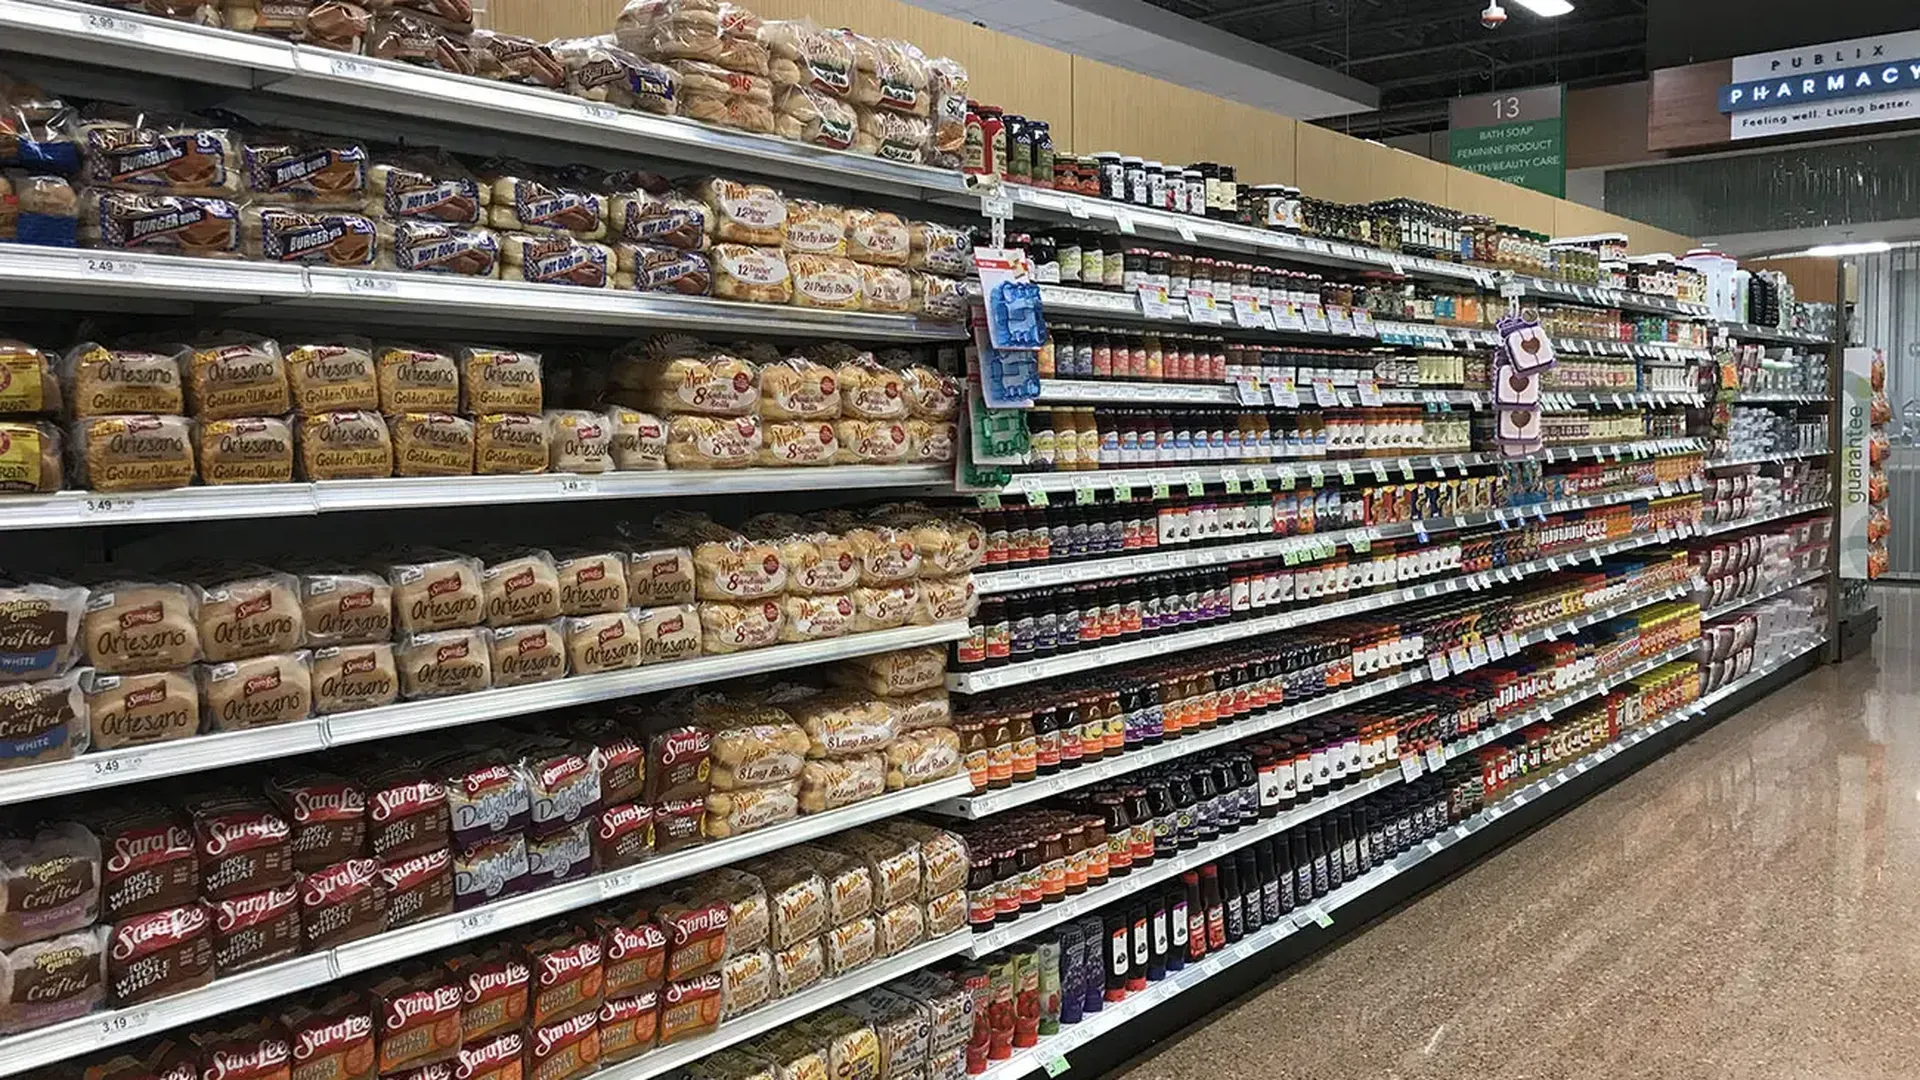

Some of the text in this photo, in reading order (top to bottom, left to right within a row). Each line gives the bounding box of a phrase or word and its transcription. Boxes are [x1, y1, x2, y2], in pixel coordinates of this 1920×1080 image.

[89, 15, 114, 29] 2.99
[1771, 45, 1883, 71] PUBLIX
[1731, 65, 1920, 104] PHARMACY
[1493, 97, 1520, 119] 13
[1742, 100, 1912, 127] Feeling well. Living better.
[1480, 126, 1533, 140] BATH SOAP
[1457, 139, 1552, 158] FEMININE PRODUCT
[1461, 155, 1560, 173] ALTH/BEAUTY CARE
[735, 207, 749, 218] 12
[133, 213, 178, 237] BURGER
[419, 249, 437, 262] HOT
[438, 243, 455, 257] DOG
[88, 259, 113, 272] 2.49
[738, 264, 749, 275] 12
[814, 282, 834, 296] Party
[98, 361, 172, 383] Artesano
[208, 362, 274, 381] Artesano
[306, 361, 366, 378] Artesano
[92, 393, 178, 409] Golden Wheat
[206, 387, 283, 408] Golden Wheat
[305, 386, 374, 403] Golden Wheat
[693, 386, 706, 406] 8
[921, 440, 931, 456] 8
[1849, 404, 1867, 504] guarantee
[316, 452, 388, 467] Golden Wheat
[106, 464, 191, 481] Golden Wheat
[213, 464, 290, 480] Golden Wheat
[87, 501, 112, 512] 3.49
[871, 557, 883, 574] 8
[726, 572, 740, 591] 8
[411, 595, 477, 621] Artesano
[490, 588, 553, 616] Artesano
[877, 601, 887, 619] 8
[934, 602, 948, 619] 8
[214, 616, 293, 644] Artesano
[318, 612, 389, 633] Artesano
[0, 628, 53, 648] rafted
[98, 629, 187, 655] Artesano
[734, 625, 746, 644] 8
[1, 656, 36, 666] WHITE
[502, 652, 561, 674] Artesano
[584, 640, 639, 665] Artesano
[417, 662, 484, 683] Artesano
[321, 676, 392, 697] Artesano
[222, 691, 300, 722] Artesano
[101, 708, 188, 736] Artesano
[15, 736, 50, 752] WHITE
[663, 731, 710, 764] Sara Lee
[827, 733, 881, 750] 8 Long Rolls
[95, 760, 119, 774] 3.49
[738, 764, 791, 780] 8 Long Rolls
[906, 757, 950, 775] 8 Long Rolls
[294, 787, 365, 821] Sara Lee
[372, 779, 446, 821] Sara Lee
[373, 822, 417, 847] WHOLE
[374, 831, 416, 853] WHEAT
[108, 826, 195, 872] Sara Lee
[206, 859, 256, 885] WHOLE
[206, 868, 255, 892] WHEAT
[304, 858, 379, 906] Sara Lee
[23, 880, 82, 909] Crafted
[110, 874, 163, 902] WHOLE
[110, 886, 162, 911] WHEAT
[217, 881, 298, 931] Sara Lee
[307, 908, 353, 933] WHOLE
[308, 917, 352, 941] WHEAT
[675, 908, 729, 945] Sara Lee
[113, 907, 204, 960] Sara Lee
[216, 930, 265, 959] WHOLE
[217, 940, 263, 967] WHEAT
[115, 959, 170, 990] WHOLE
[117, 972, 167, 999] WHEAT
[464, 961, 530, 1003] Sara Lee
[27, 974, 87, 1001] Crafted
[387, 987, 462, 1029] Sara Lee
[102, 1017, 127, 1033] 3.19
[293, 1013, 372, 1059] Sara Lee
[535, 1011, 598, 1057] Sara Lee
[203, 1039, 288, 1080] Sara Lee
[455, 1033, 523, 1079] Sara Lee
